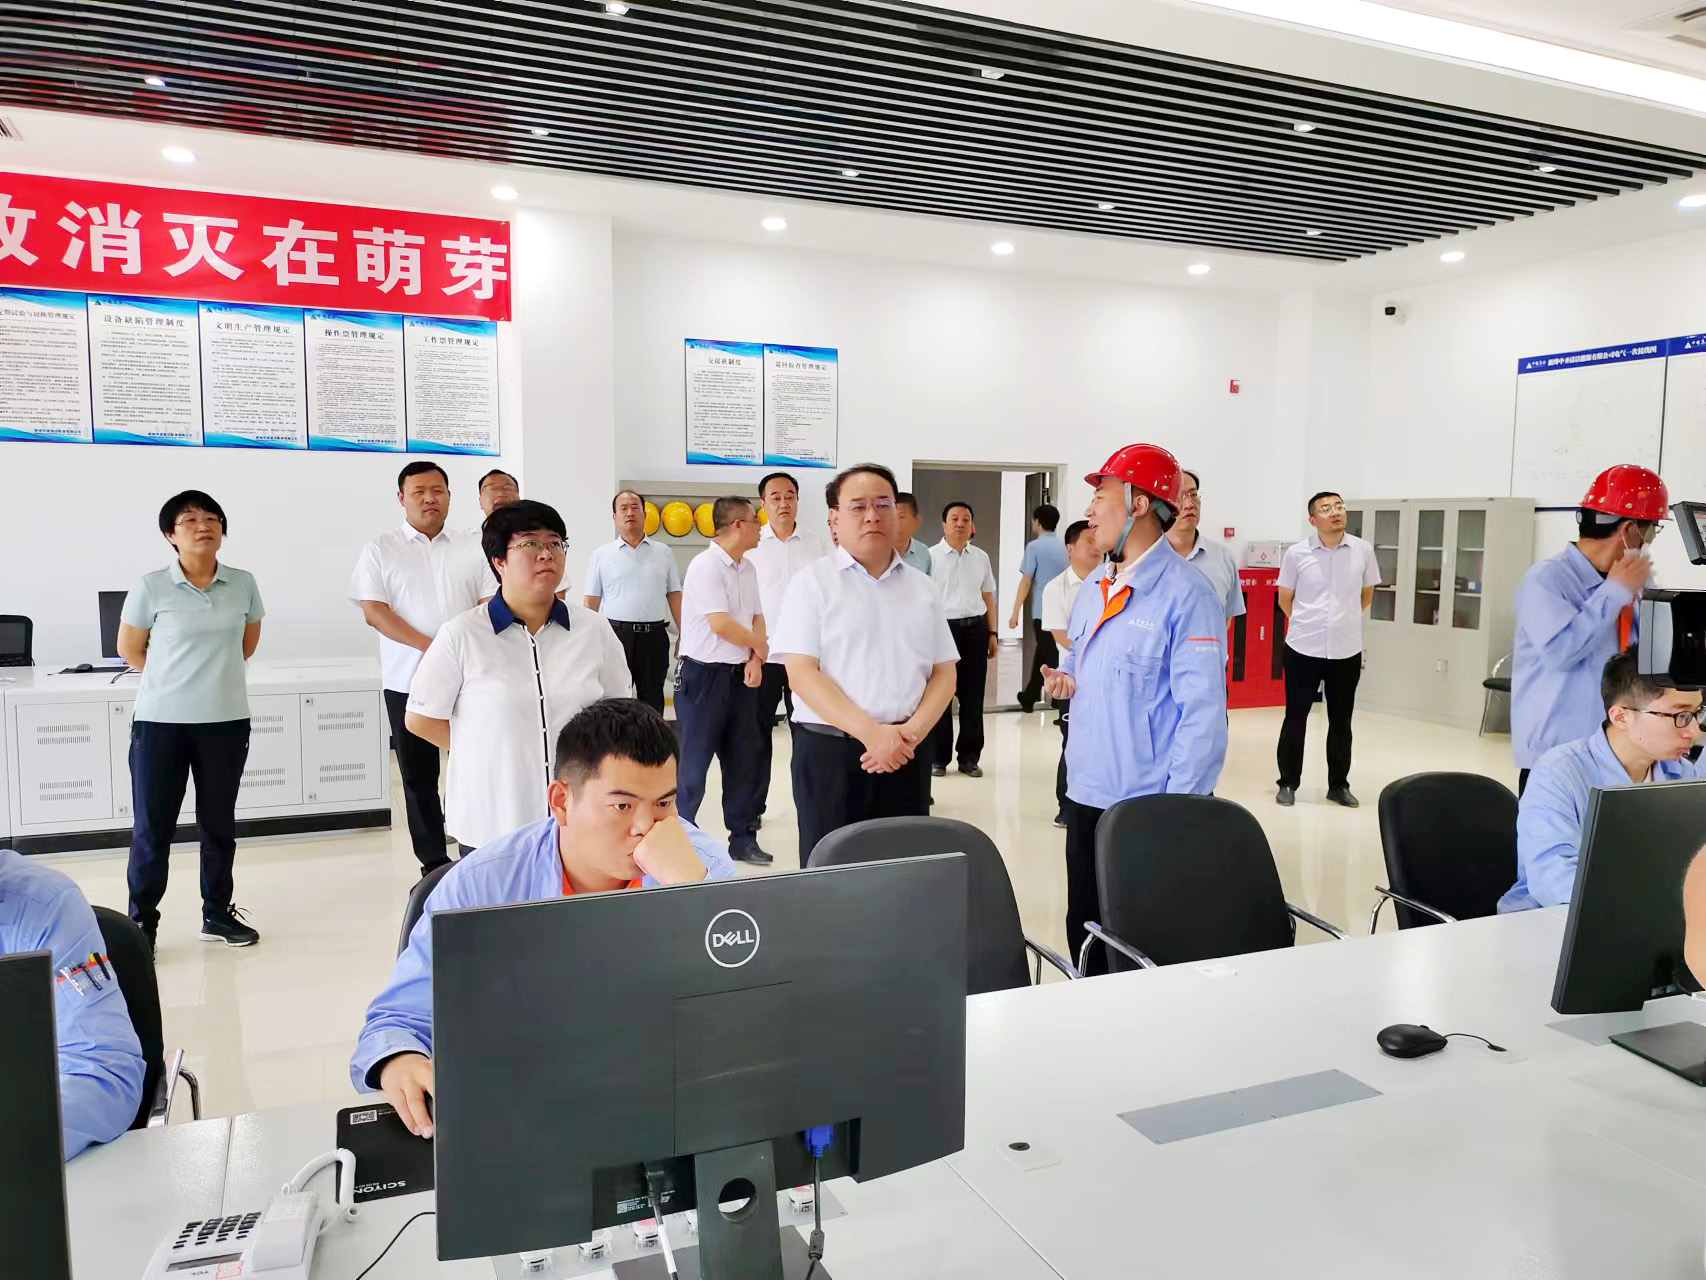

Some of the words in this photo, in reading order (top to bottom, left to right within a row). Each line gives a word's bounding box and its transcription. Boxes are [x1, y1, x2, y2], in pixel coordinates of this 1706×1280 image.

[104, 314, 185, 328] 设备缺陷管理制度
[215, 321, 291, 334] 文明生产管理规定
[324, 328, 385, 340] 操作票管理规定
[423, 335, 480, 347] 工作票管理规定
[707, 356, 742, 366] 交接班制度
[712, 929, 755, 948] DELL
